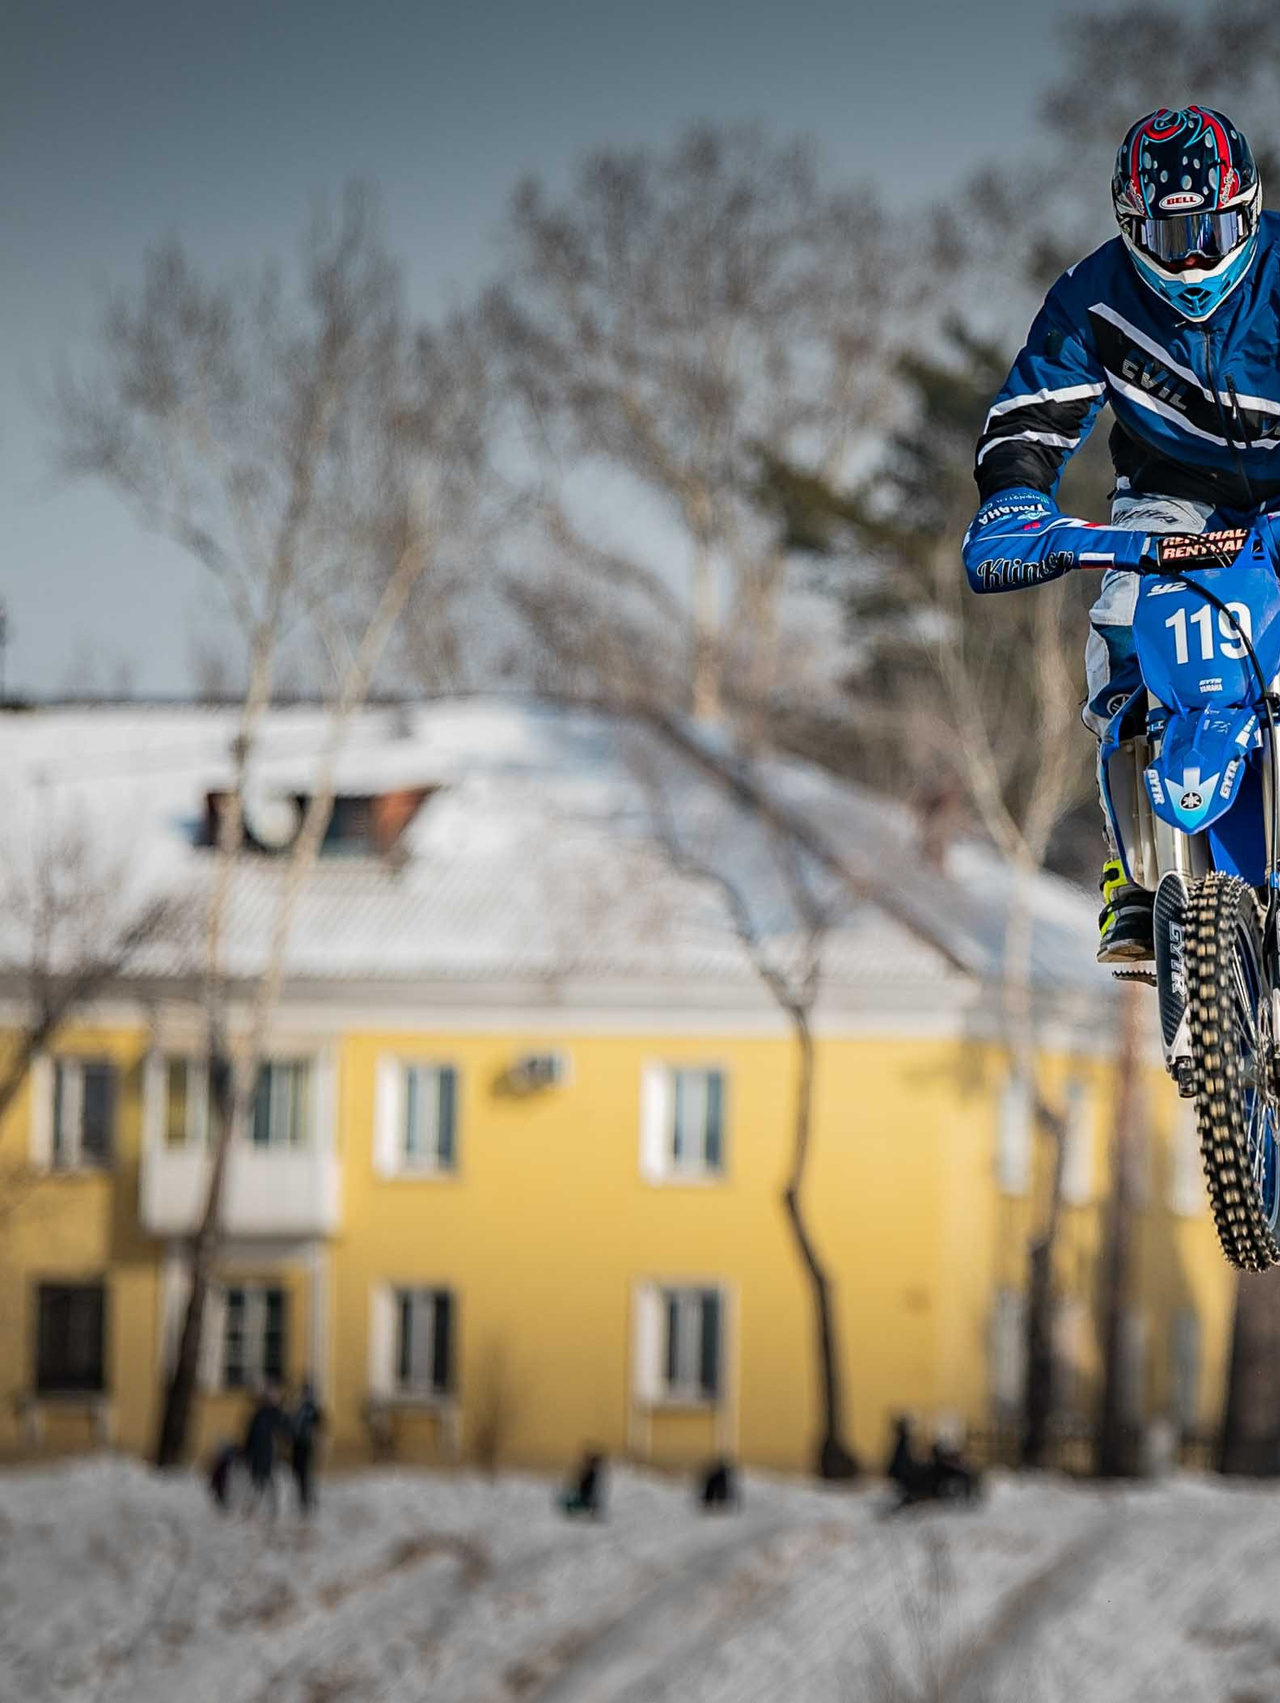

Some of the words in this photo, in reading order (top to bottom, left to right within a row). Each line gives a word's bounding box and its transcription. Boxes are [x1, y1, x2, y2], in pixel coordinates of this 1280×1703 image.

[1166, 196, 1197, 205] BELL
[1122, 349, 1187, 411] EVIL
[1165, 602, 1253, 665] 119
[1147, 768, 1166, 805] GYTR
[1219, 759, 1239, 800] GYTR
[1169, 920, 1187, 996] GYTR
